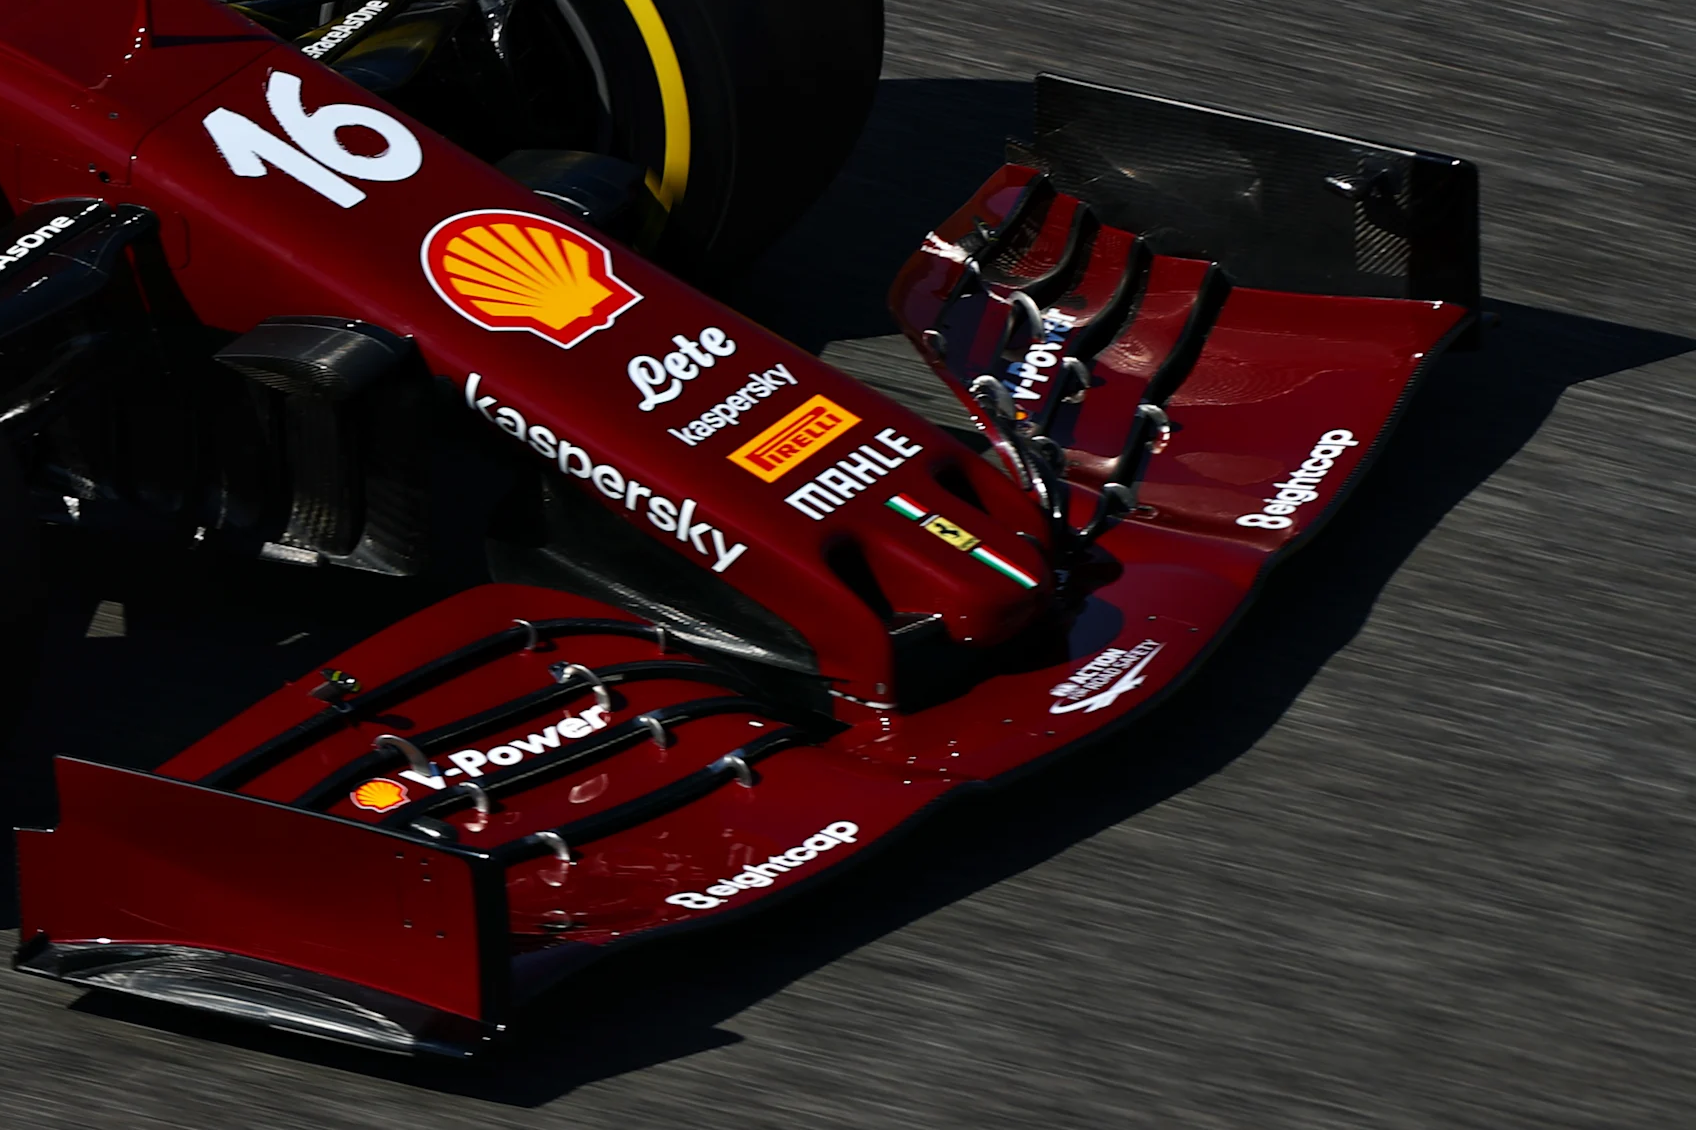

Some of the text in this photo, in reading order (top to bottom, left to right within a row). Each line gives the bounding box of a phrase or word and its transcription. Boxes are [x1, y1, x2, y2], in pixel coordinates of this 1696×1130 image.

[202, 68, 423, 209] 16
[627, 326, 736, 412] Lete
[666, 362, 798, 446] kaspersky
[465, 372, 747, 573] kaspersky
[744, 405, 844, 472] PIRELLI
[784, 427, 924, 521] MAHLE
[1068, 647, 1128, 685] ACTION
[398, 704, 610, 791] V-Power
